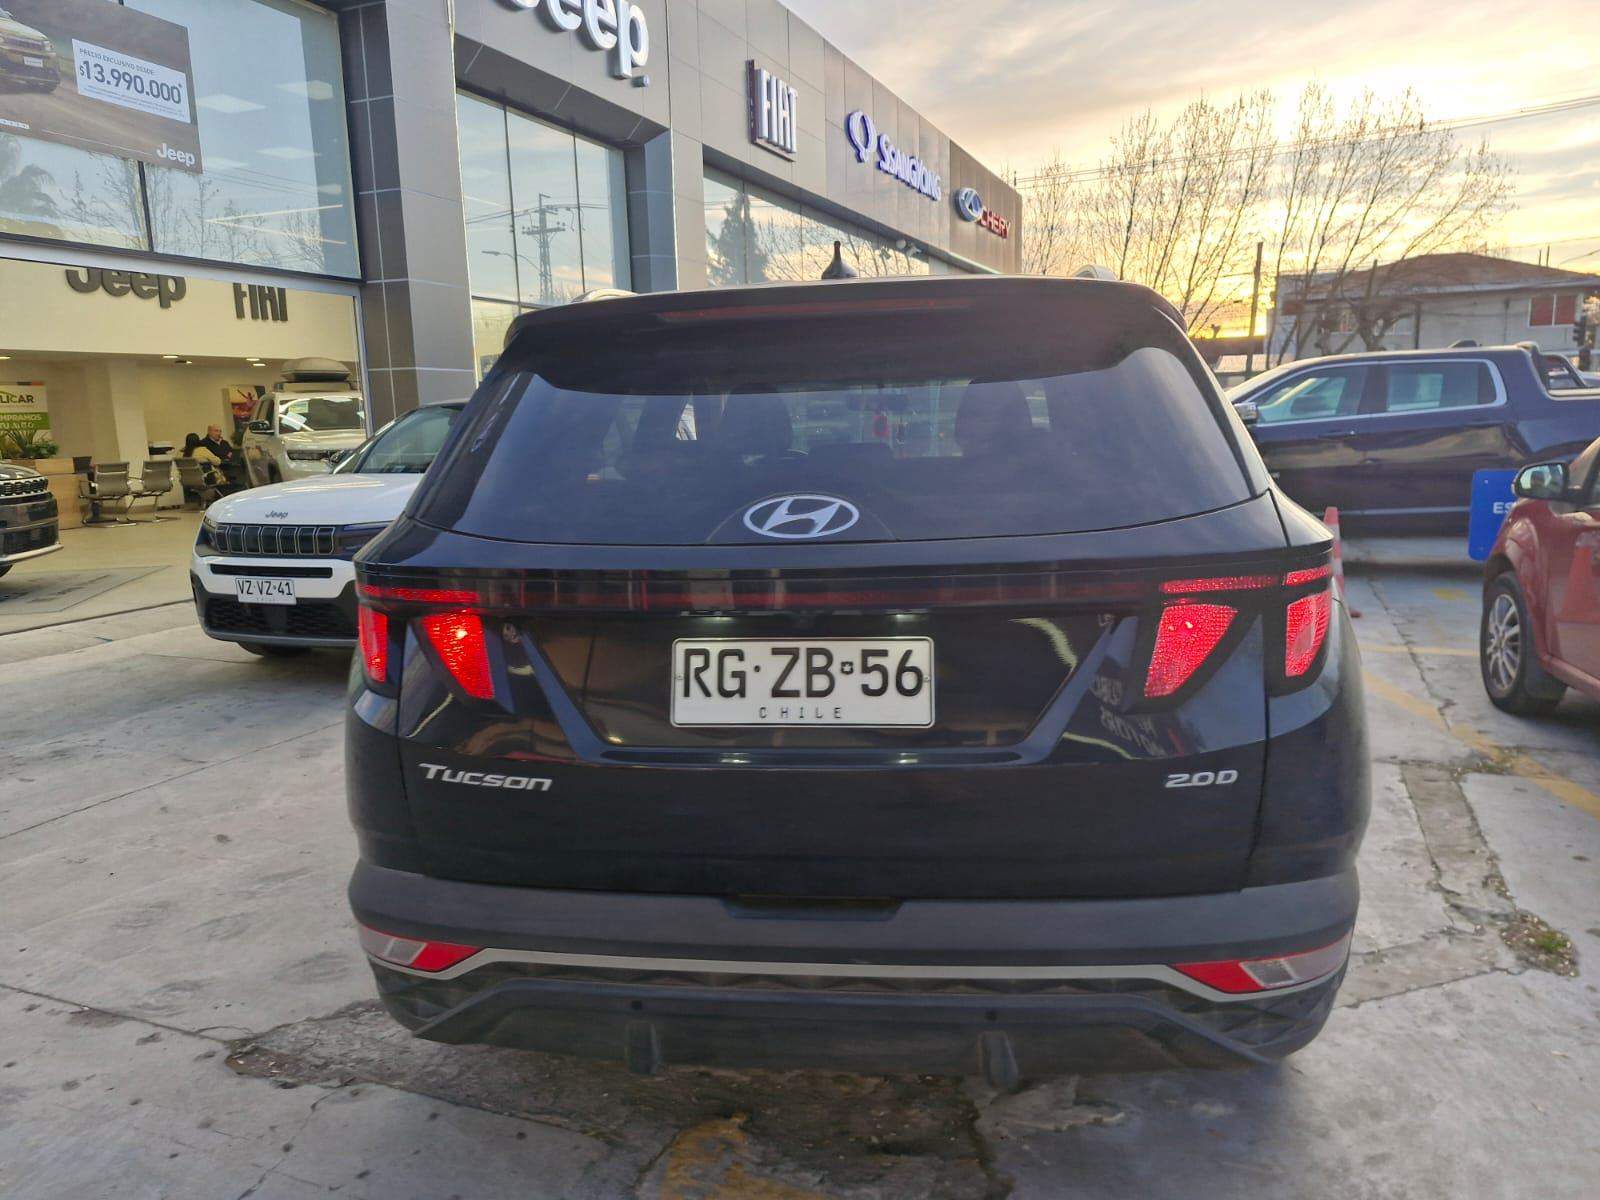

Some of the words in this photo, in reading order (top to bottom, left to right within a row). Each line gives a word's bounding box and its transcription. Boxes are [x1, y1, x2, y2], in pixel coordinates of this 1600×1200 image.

[494, 0, 650, 79] eep
[758, 68, 798, 154] FIAT
[156, 142, 196, 167] Jeep
[265, 510, 289, 519] Jeep
[758, 706, 843, 719] CHILE
